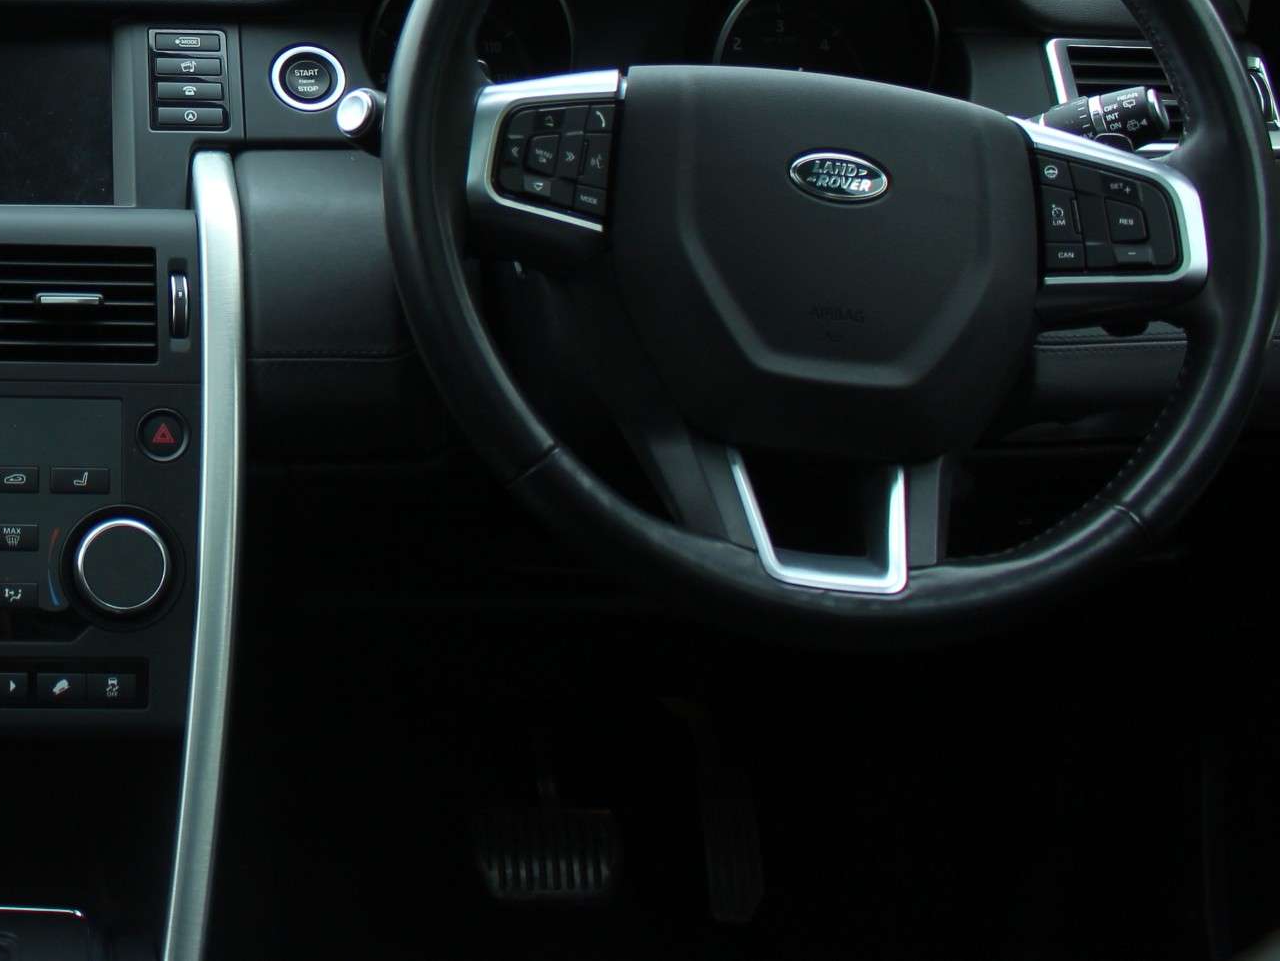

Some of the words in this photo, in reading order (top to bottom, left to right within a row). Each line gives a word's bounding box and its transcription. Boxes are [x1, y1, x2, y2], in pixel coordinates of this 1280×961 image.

[294, 69, 319, 77] START
[1103, 103, 1119, 114] OFF
[1105, 112, 1120, 122] INT
[1109, 121, 1122, 131] ON
[812, 160, 858, 177] LAND
[816, 175, 872, 192] ROVER
[1051, 218, 1067, 227] LIM
[3, 527, 22, 536] MAX
